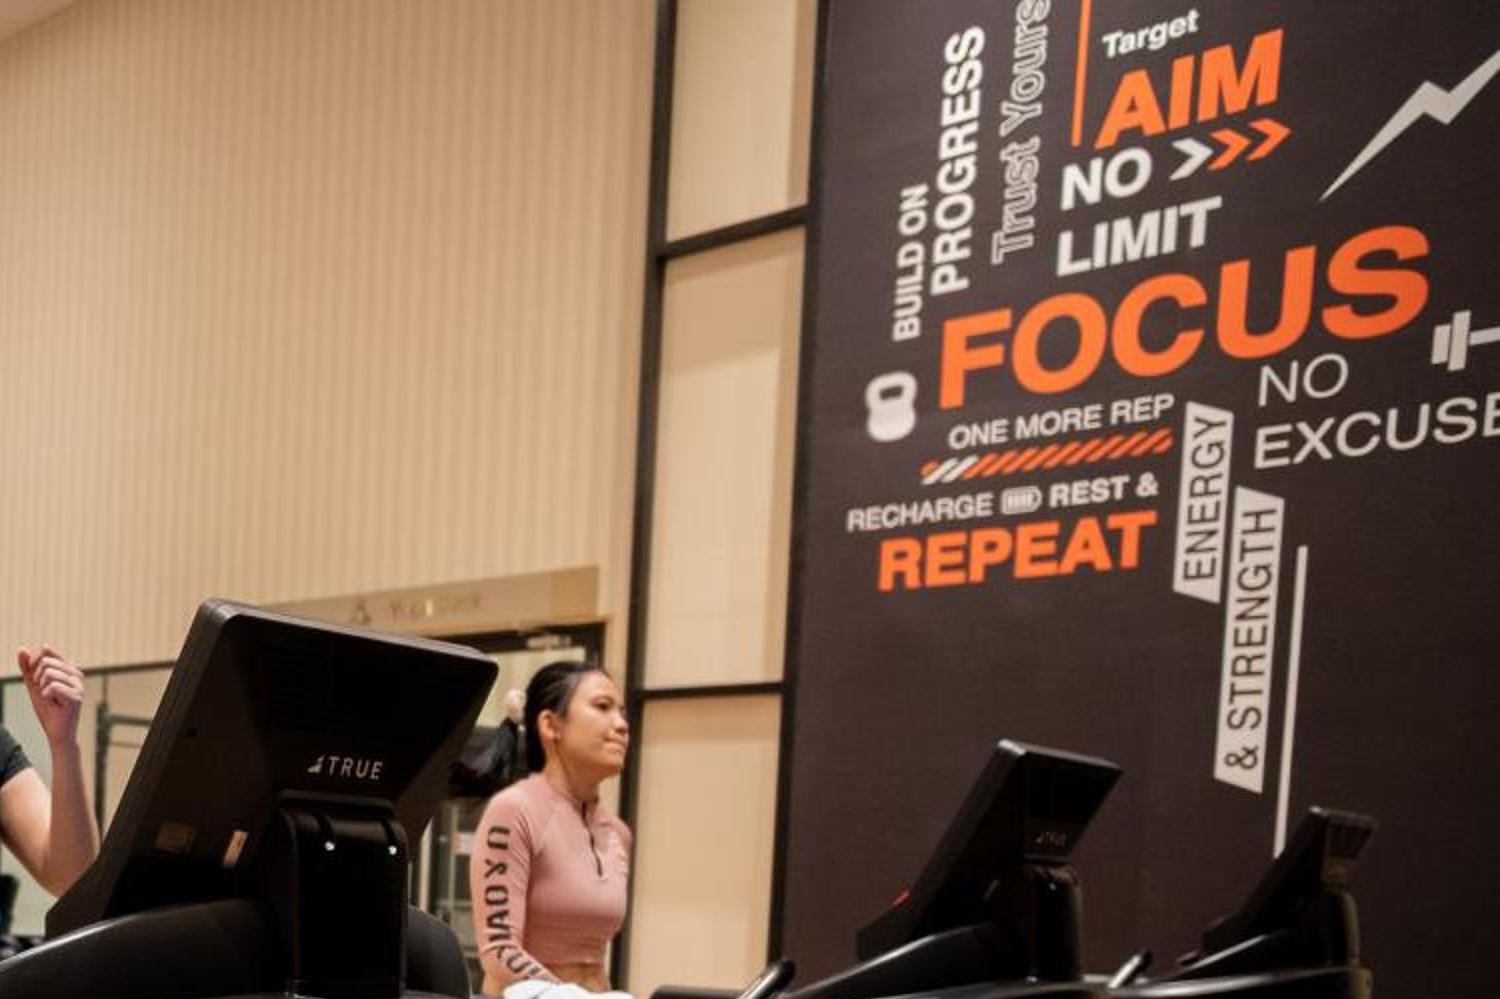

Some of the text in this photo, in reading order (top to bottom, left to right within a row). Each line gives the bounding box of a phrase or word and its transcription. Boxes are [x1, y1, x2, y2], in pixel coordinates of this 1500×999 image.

[1102, 9, 1199, 58] Target
[1095, 28, 1283, 149] AIM
[931, 26, 985, 294] PROGRESS
[1060, 146, 1152, 211] NO
[991, 137, 1040, 265] Trust
[1056, 196, 1222, 276] LIMIT
[893, 184, 929, 341] BUILD ON
[939, 225, 1429, 410] FOCUS
[1258, 353, 1349, 407] NO
[948, 394, 1175, 450] ONE MORE REP
[847, 472, 1159, 533] RECHARGE REST &
[1183, 415, 1227, 581] ENERGY
[877, 510, 1157, 591] REPEAT
[1224, 508, 1277, 770] & STRENGTH
[328, 755, 384, 780] TRUE
